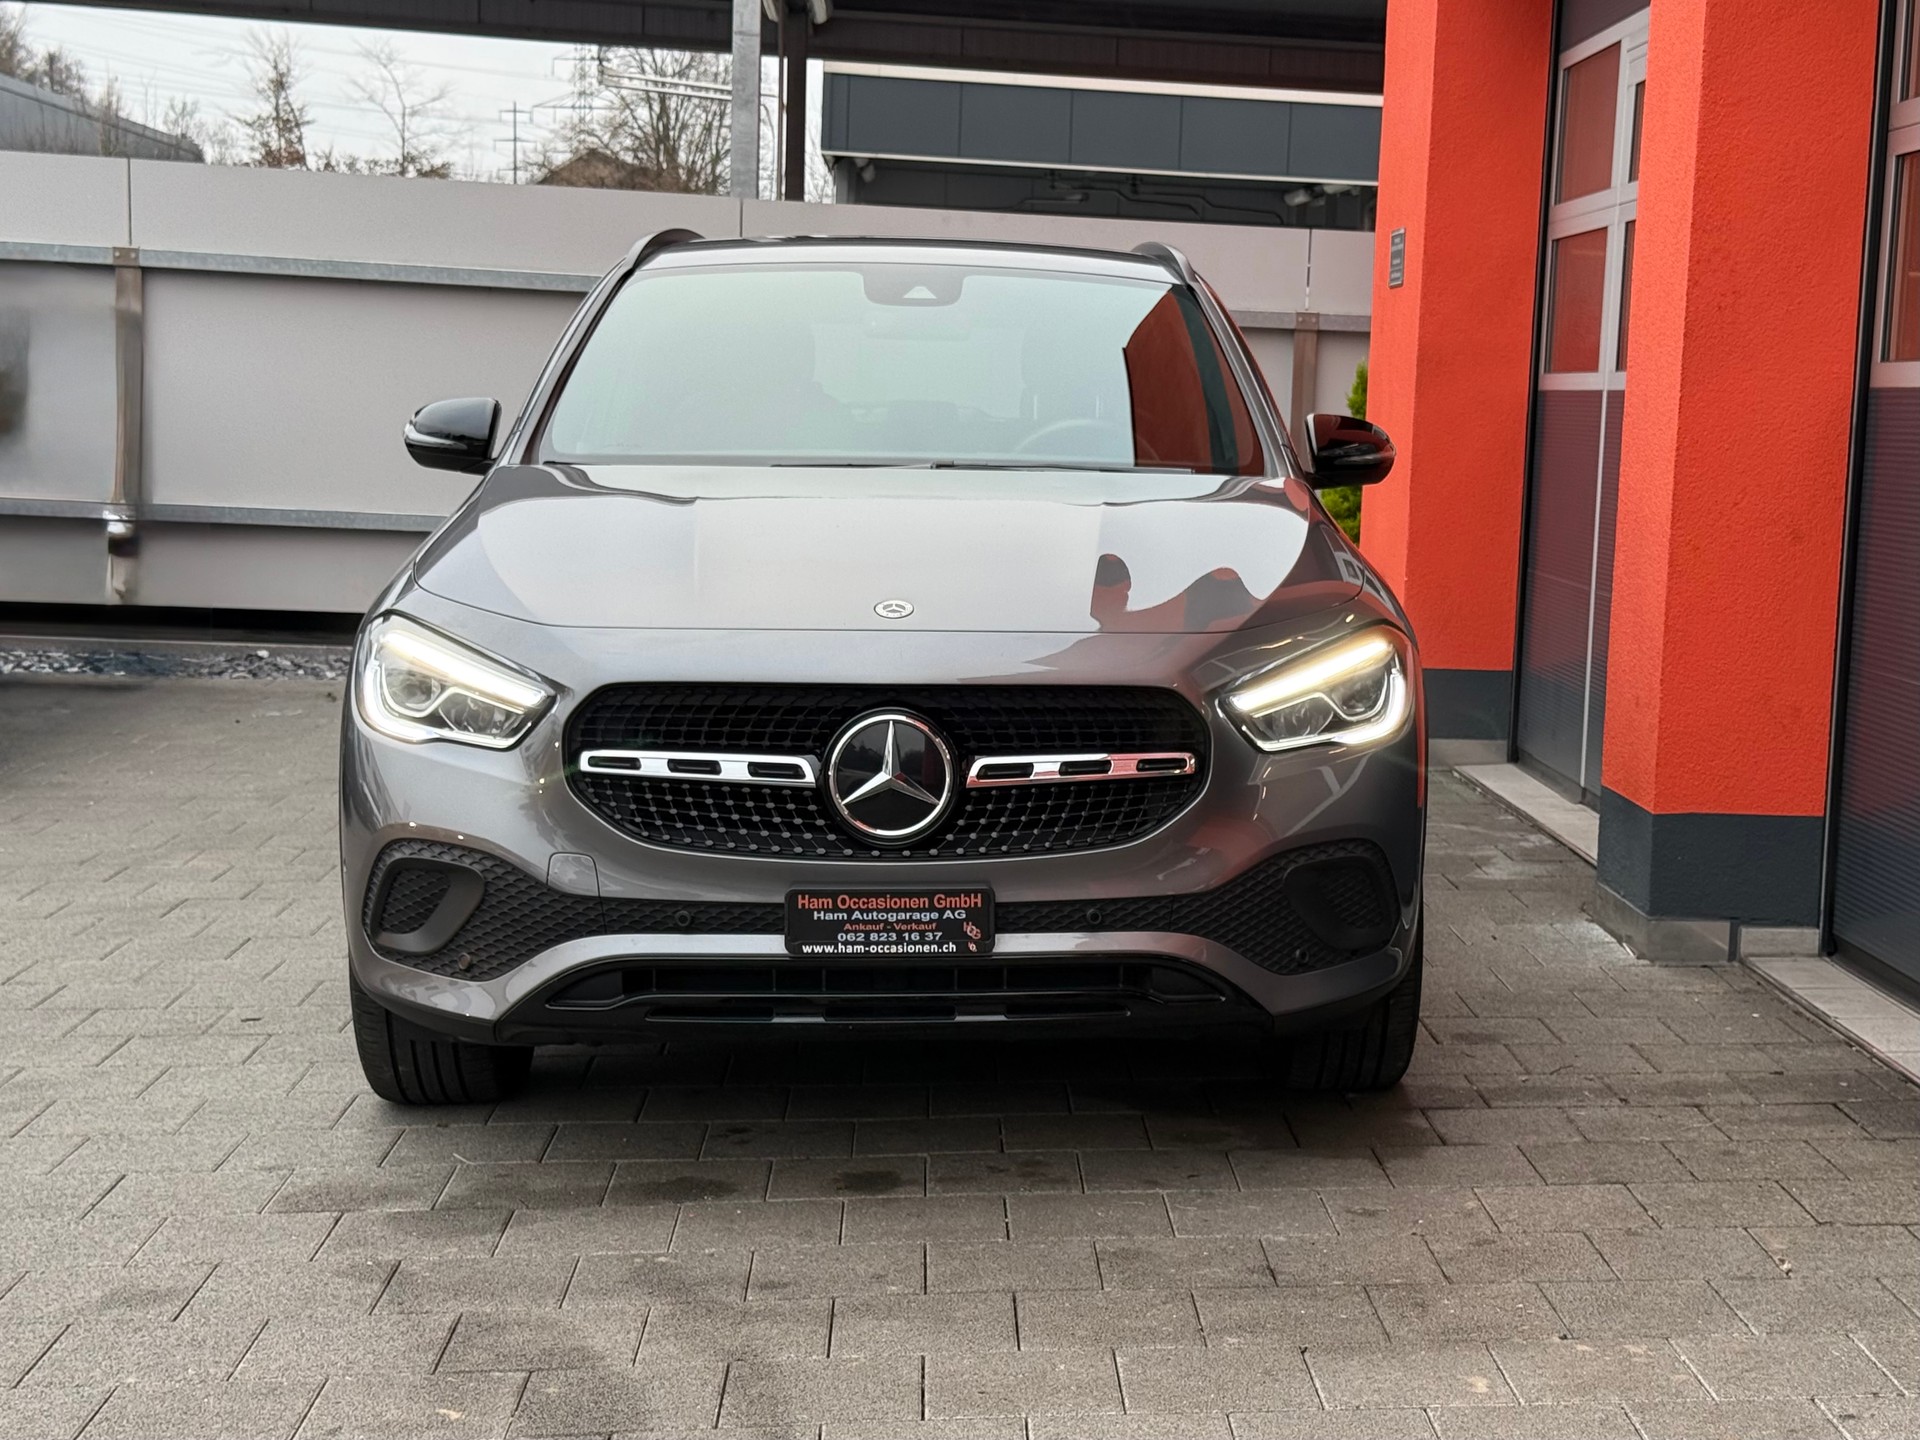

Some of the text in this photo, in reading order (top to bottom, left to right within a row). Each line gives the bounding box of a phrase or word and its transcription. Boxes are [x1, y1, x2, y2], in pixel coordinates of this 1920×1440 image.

[798, 893, 981, 909] Ham Occasionen GmbH
[814, 910, 966, 921] Ham Autogarage AG
[838, 932, 943, 941] 062 823 16 37
[802, 942, 956, 953] www.ham-occasionen.ch
